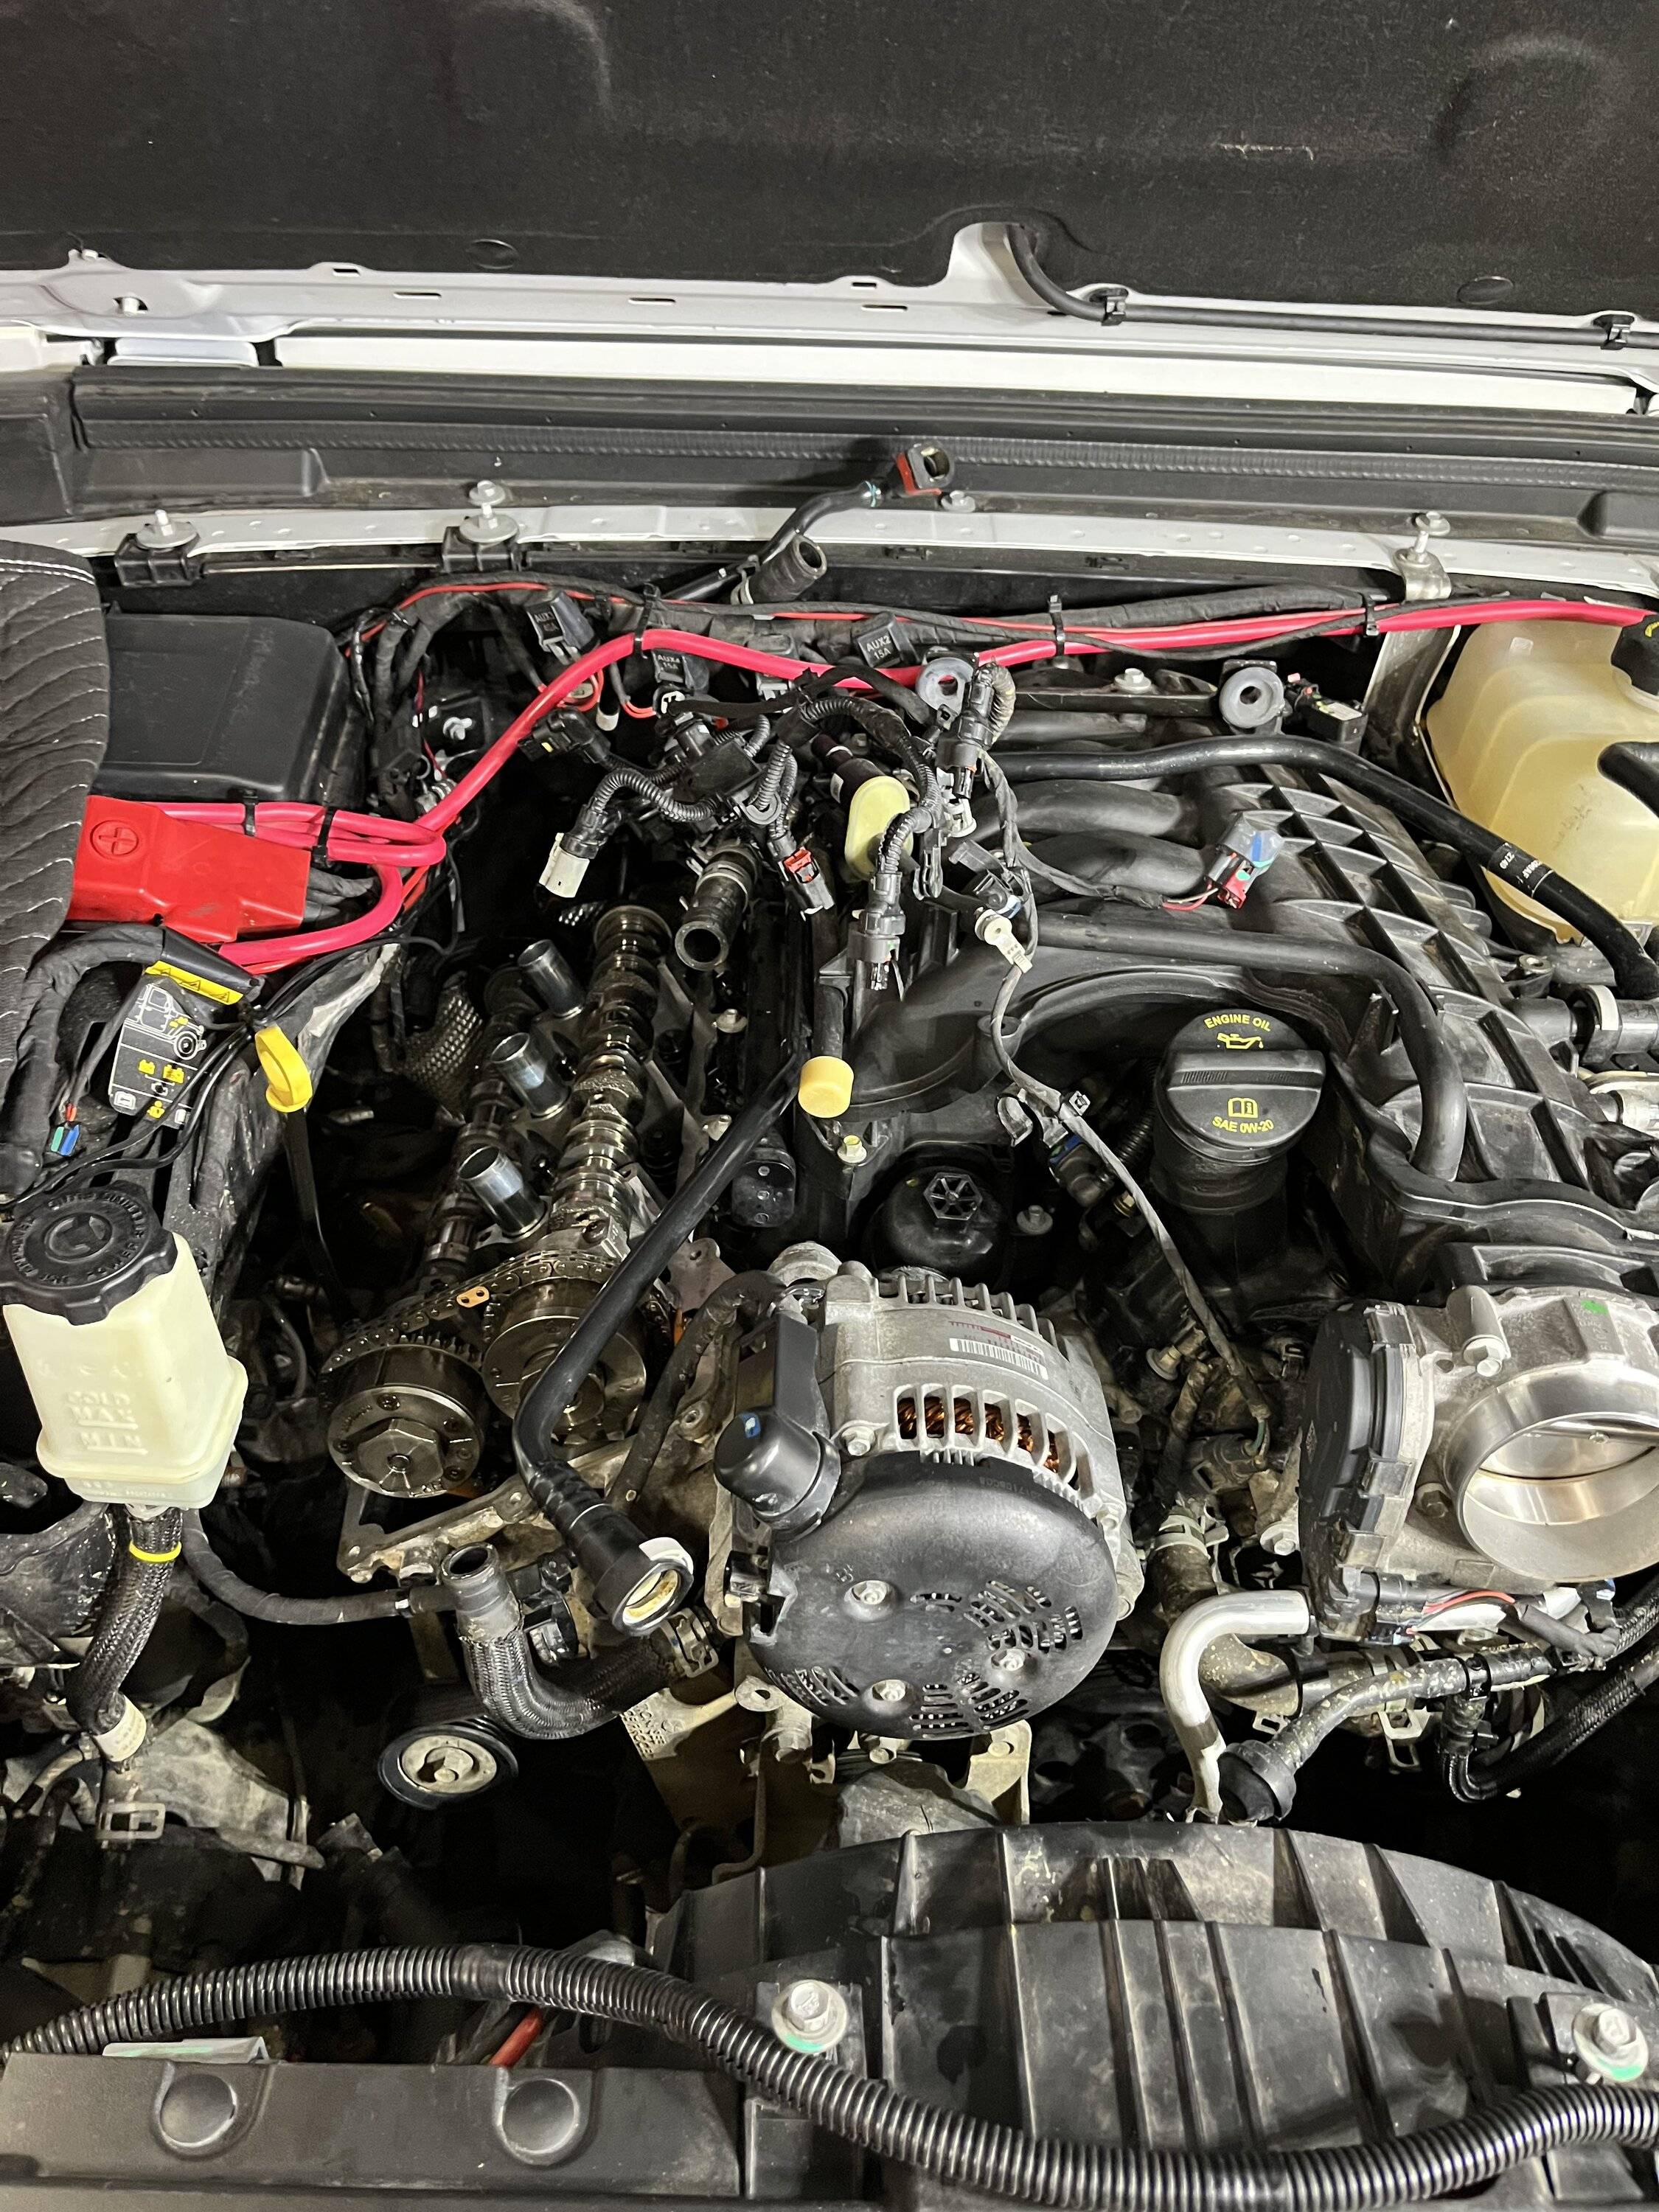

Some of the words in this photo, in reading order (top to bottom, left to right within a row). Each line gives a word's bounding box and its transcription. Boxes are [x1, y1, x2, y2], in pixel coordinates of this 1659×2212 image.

[866, 635, 891, 652] AUX2
[874, 647, 891, 659] 15A
[1204, 1014, 1251, 1029] ENGINE
[1252, 1018, 1271, 1032] OIL
[1212, 1116, 1238, 1133] SAE
[1239, 1119, 1274, 1133] 0W-20
[71, 1405, 136, 1422] MAX
[79, 1431, 141, 1447] MIN
